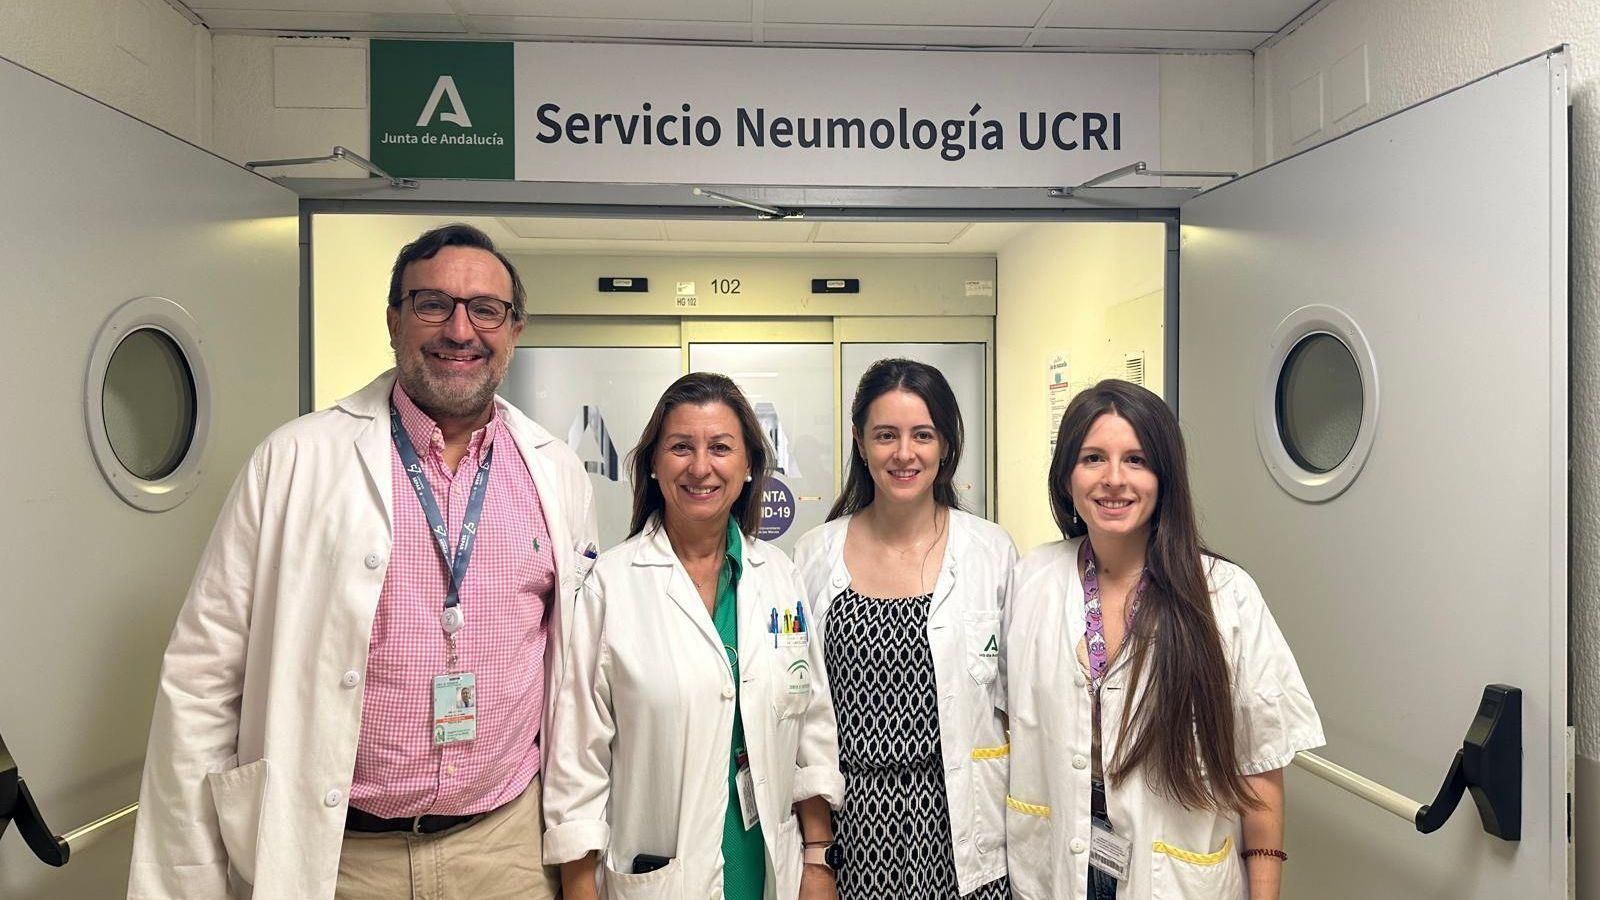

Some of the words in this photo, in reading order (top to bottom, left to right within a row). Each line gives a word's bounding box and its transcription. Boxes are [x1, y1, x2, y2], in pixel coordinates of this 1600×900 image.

[381, 132, 418, 144] Junta
[421, 132, 437, 145] de
[440, 132, 504, 146] Andalucía
[536, 102, 721, 147] Servicio
[736, 102, 1004, 162] Neumología
[1019, 111, 1121, 151] UCRI
[711, 279, 741, 294] 102
[688, 297, 697, 306] 102
[761, 490, 787, 503] NTA
